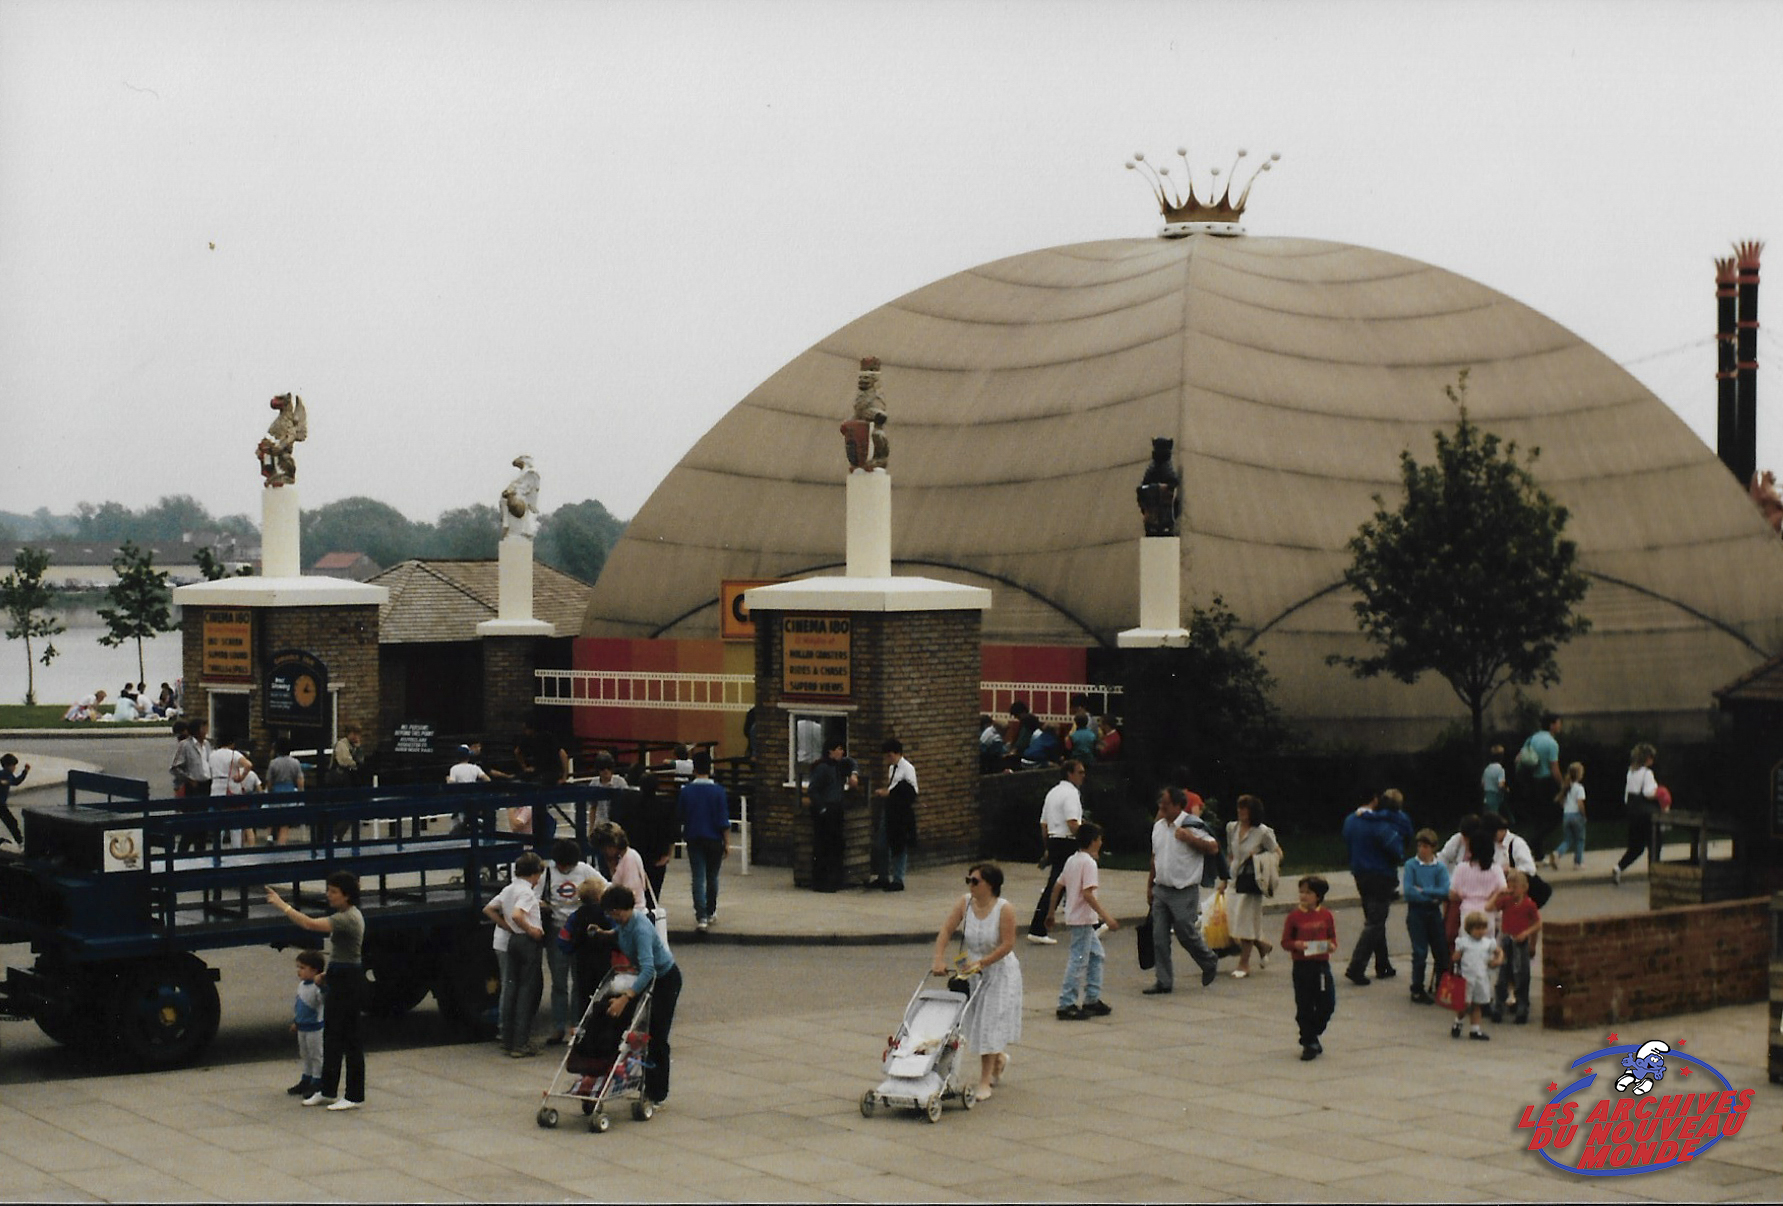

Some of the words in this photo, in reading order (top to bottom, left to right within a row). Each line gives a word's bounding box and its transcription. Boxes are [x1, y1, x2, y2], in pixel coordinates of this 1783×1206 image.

[203, 612, 233, 624] CINEMA
[235, 612, 250, 624] 180
[785, 619, 827, 633] CINEMA
[829, 620, 849, 634] 180
[815, 650, 848, 660] COASTERS
[789, 665, 811, 675] RIDES
[820, 666, 848, 676] CHASES
[790, 681, 818, 691] SUPERB
[819, 682, 844, 692] VIEWS
